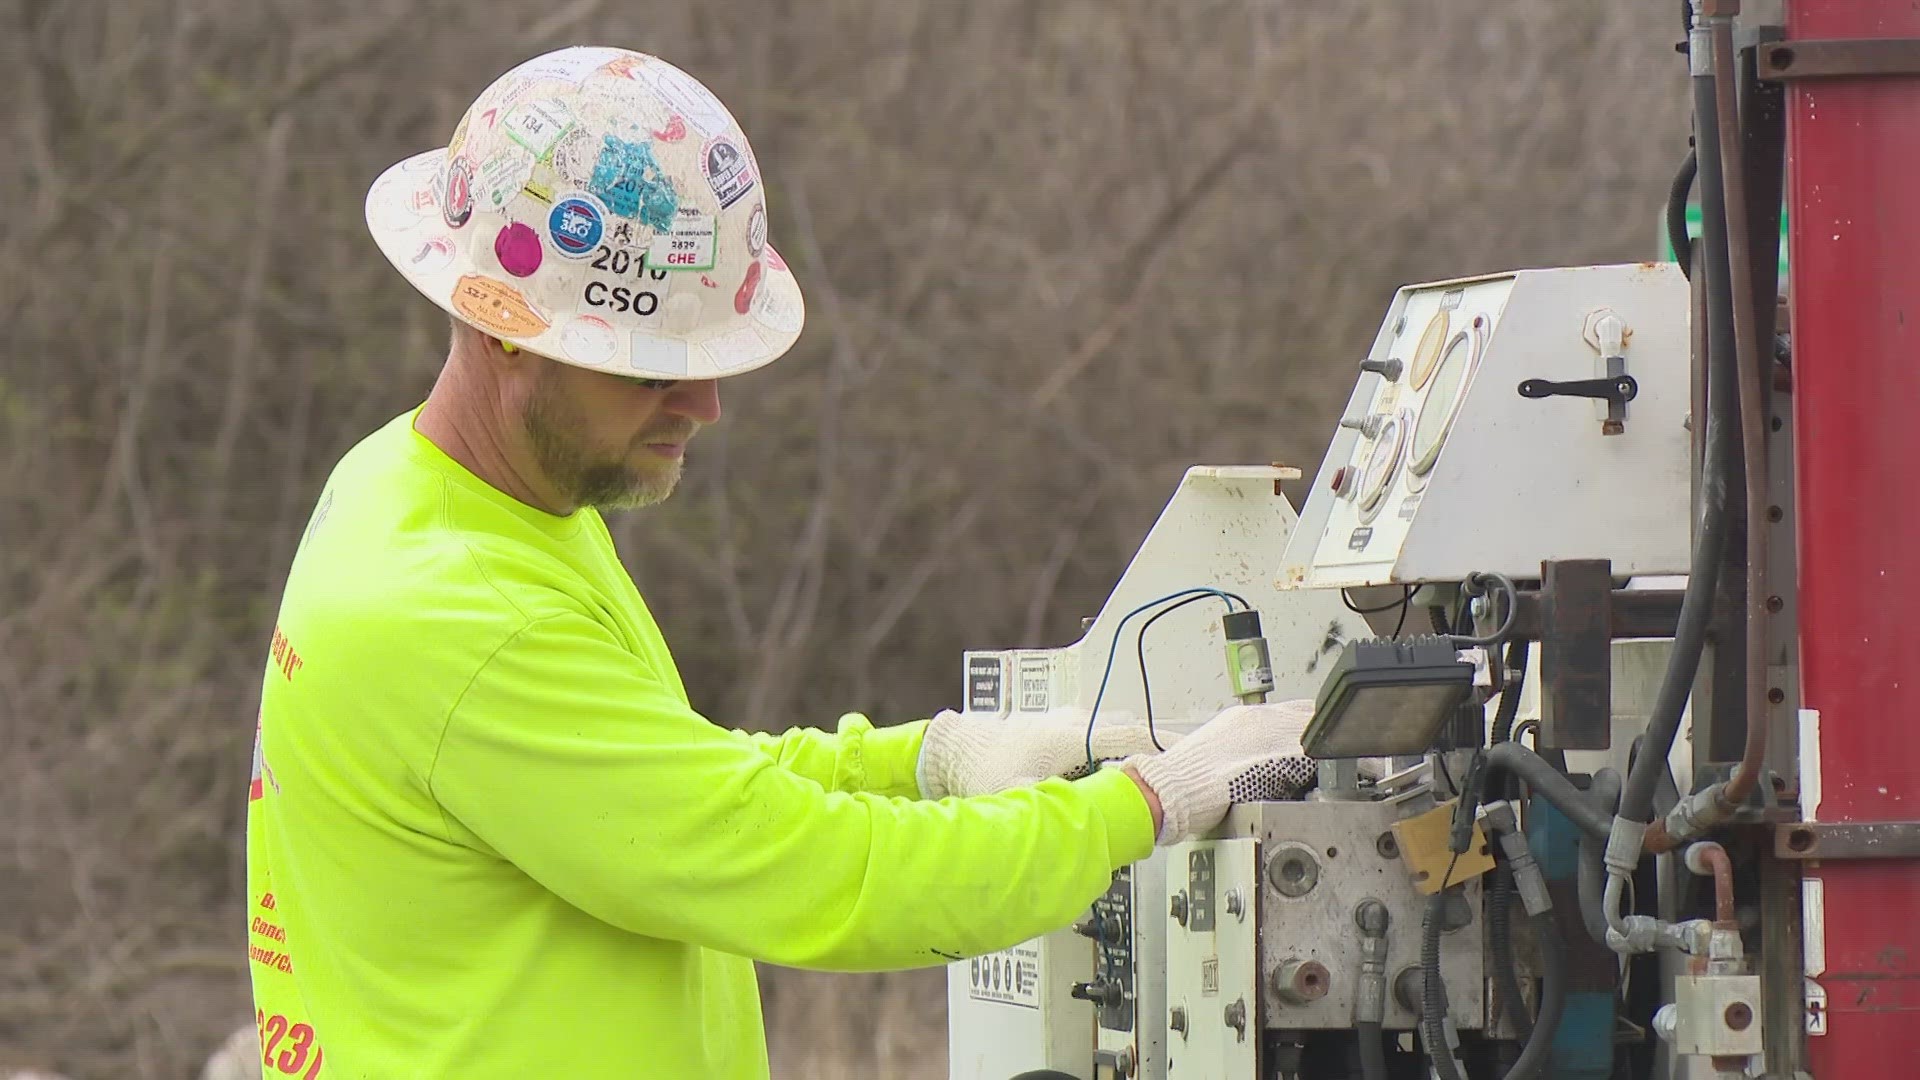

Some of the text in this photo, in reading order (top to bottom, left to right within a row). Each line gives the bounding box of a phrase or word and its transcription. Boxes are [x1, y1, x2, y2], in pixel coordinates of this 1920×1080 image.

[522, 114, 544, 134] 134
[667, 253, 697, 265] GHE
[584, 281, 658, 316] CSO
